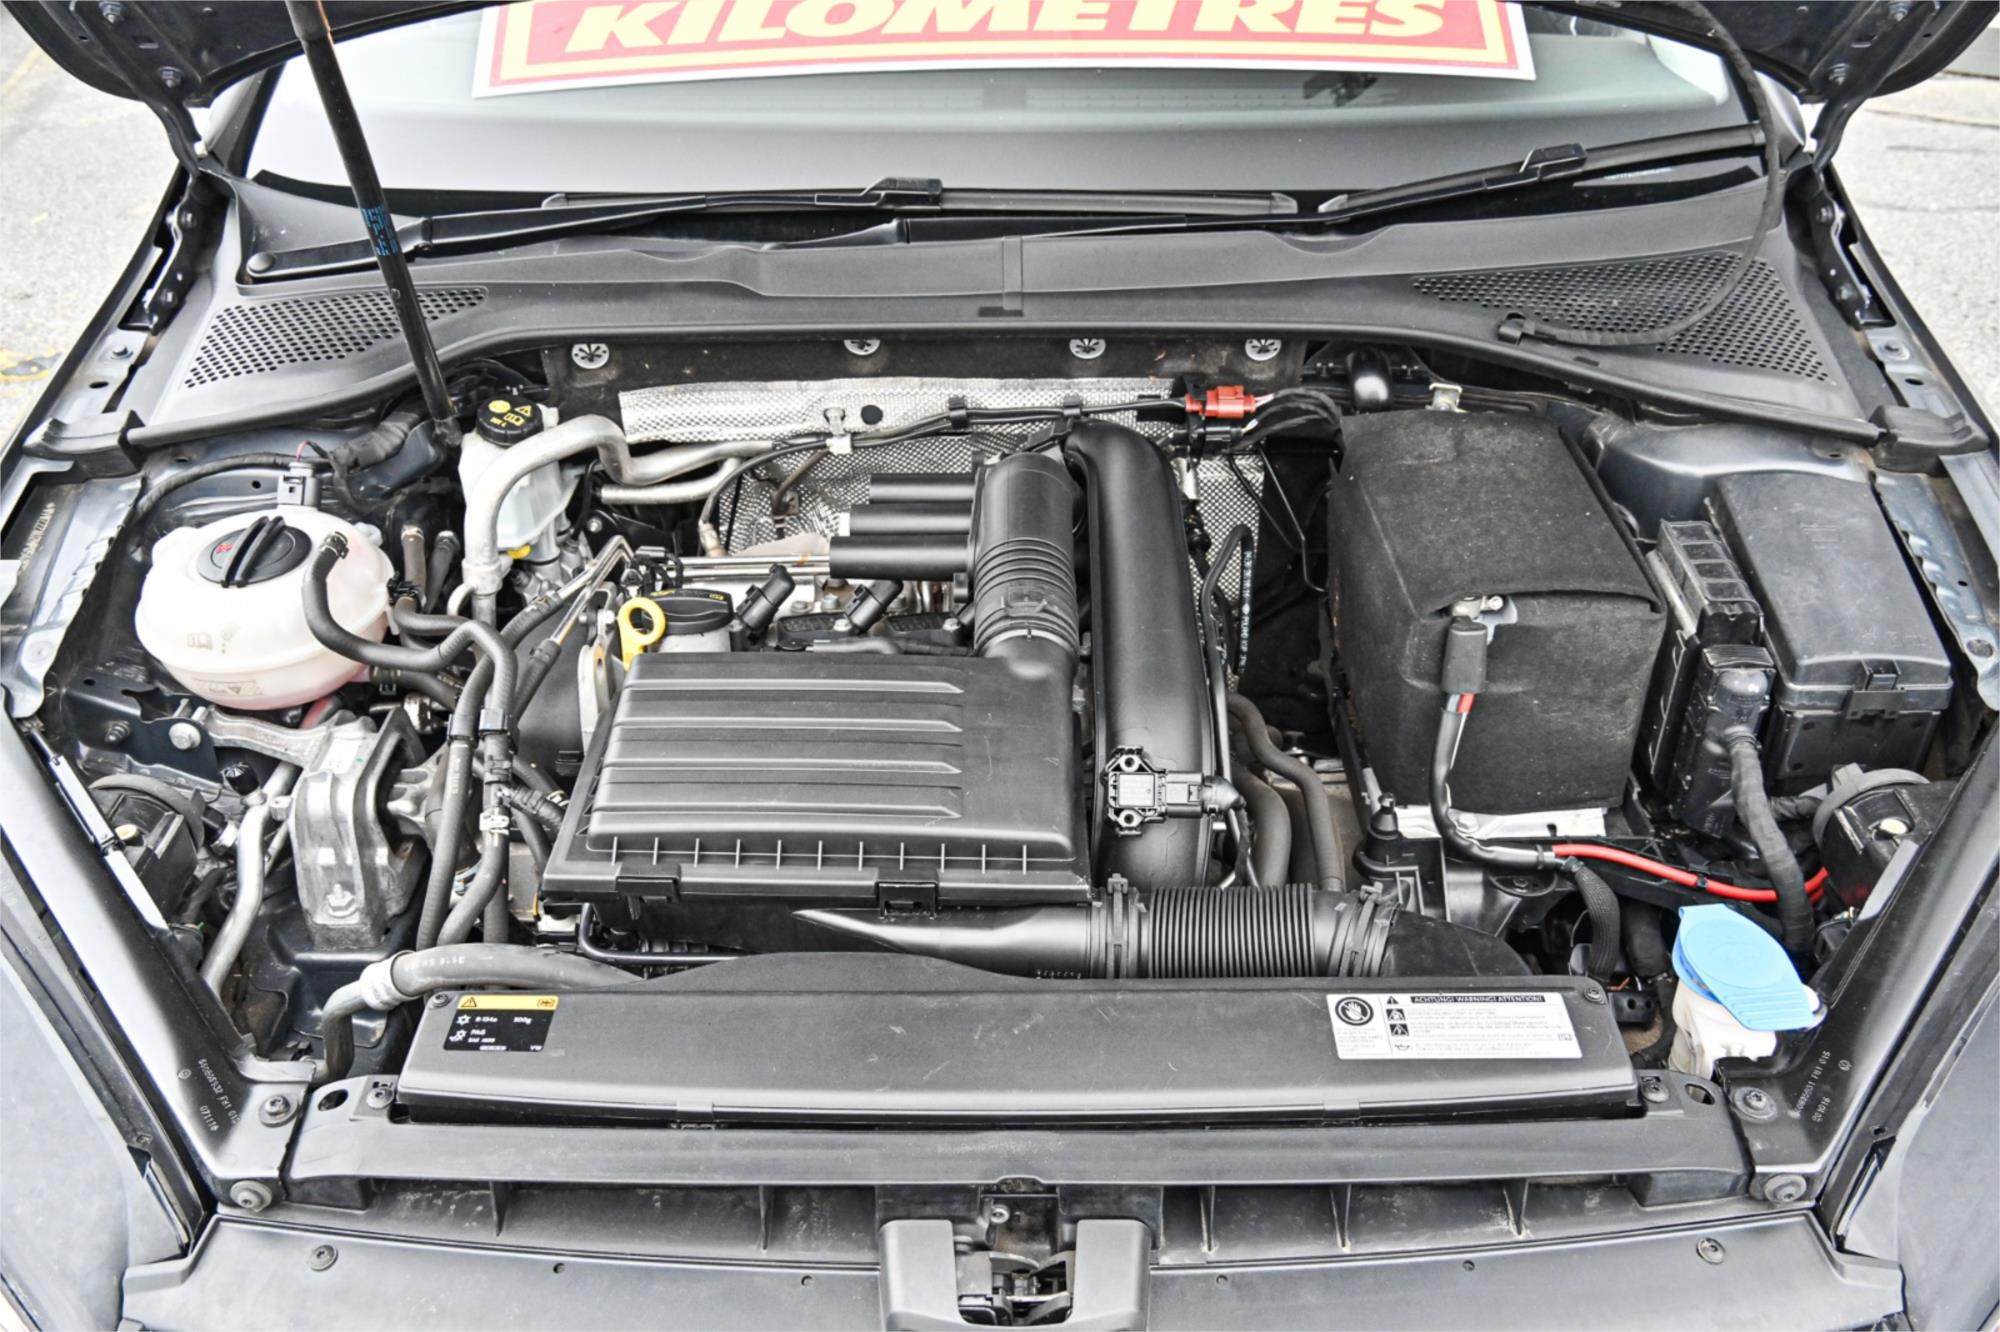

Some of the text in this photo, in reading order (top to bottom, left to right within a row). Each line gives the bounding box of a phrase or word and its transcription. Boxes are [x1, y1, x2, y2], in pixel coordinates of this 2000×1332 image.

[564, 0, 1445, 54] KILOMETRES
[1455, 995, 1497, 1003] WARNING!
[1498, 995, 1543, 1003] ATTENTION!
